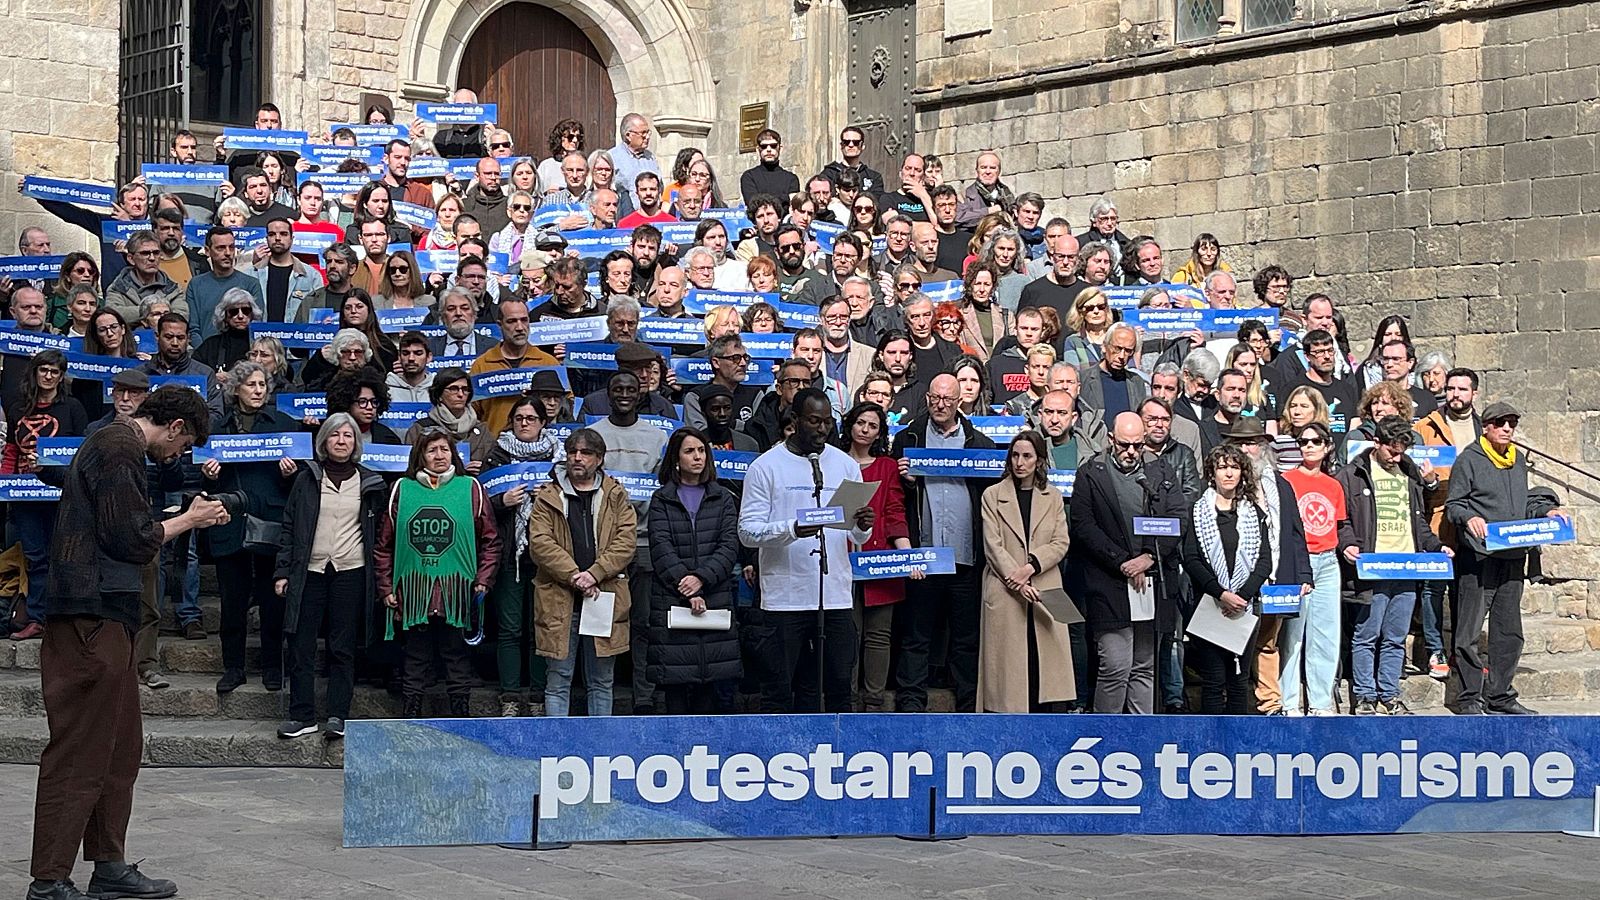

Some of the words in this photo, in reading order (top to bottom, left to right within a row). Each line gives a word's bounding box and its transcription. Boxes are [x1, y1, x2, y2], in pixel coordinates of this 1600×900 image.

[28, 183, 69, 195] protestar
[70, 188, 79, 197] és
[92, 191, 110, 200] dret
[0, 263, 37, 272] rotestar
[696, 293, 740, 302] protestar
[405, 314, 424, 324] dret
[792, 311, 802, 319] és
[1139, 311, 1180, 320] protestar
[1233, 316, 1244, 324] és
[530, 323, 575, 334] protestar
[638, 321, 682, 330] protestar
[316, 332, 334, 340] dret
[481, 327, 492, 337] és
[540, 331, 592, 341] terrorisme
[646, 330, 698, 340] terrorisme
[1, 332, 44, 344] protestar
[58, 339, 70, 348] és
[779, 341, 789, 349] és
[67, 362, 110, 372] rotestar
[111, 366, 122, 374] és
[748, 363, 758, 371] és
[479, 372, 525, 386] protestar
[416, 410, 428, 419] és
[560, 427, 571, 435] és
[998, 424, 1018, 433] dret
[211, 439, 265, 449] protestar
[280, 436, 293, 445] és
[222, 450, 282, 458] terrorisme
[721, 459, 733, 469] és
[910, 457, 960, 467] protestar
[961, 457, 973, 466] és
[989, 458, 1005, 467] dre
[483, 474, 521, 488] rotestar
[522, 472, 534, 480] és
[9, 488, 62, 497] terrorism
[413, 519, 449, 535] STOP
[1499, 524, 1537, 535] protestar
[1550, 520, 1559, 529] és
[1508, 533, 1554, 544] terrorisme
[858, 555, 908, 566] protestar
[924, 551, 936, 560] és
[868, 564, 927, 575] terrorisme
[1362, 561, 1404, 572] protestar
[1406, 561, 1415, 570] és
[1429, 561, 1448, 570] dret
[1286, 594, 1300, 603] dret
[540, 743, 933, 819] protestar
[946, 750, 1041, 800] no
[1055, 738, 1142, 800] és
[1155, 739, 1575, 800] terrorisme
